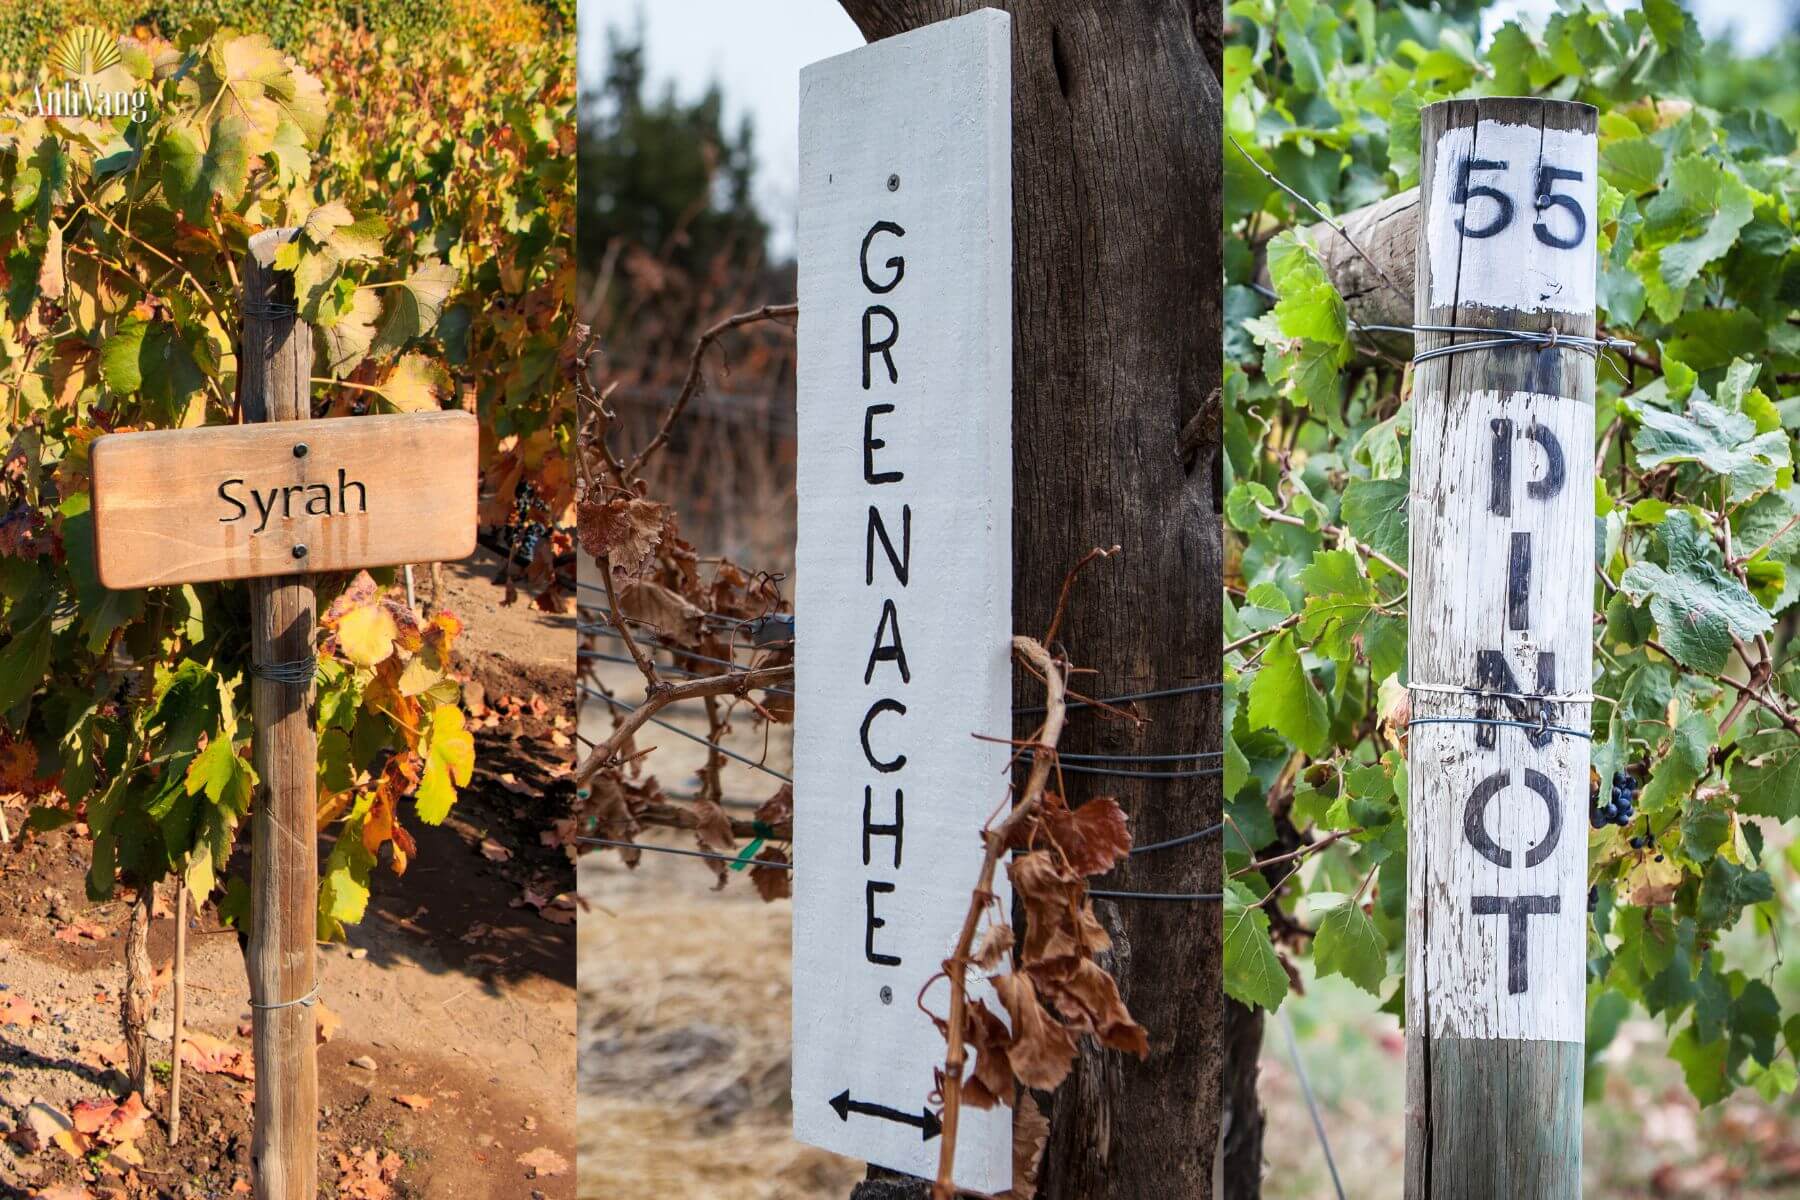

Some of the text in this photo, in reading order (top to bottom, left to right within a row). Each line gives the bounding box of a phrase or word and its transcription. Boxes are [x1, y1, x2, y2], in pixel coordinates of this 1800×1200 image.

[1453, 159, 1586, 250] 55
[217, 468, 367, 534] Syrah
[859, 219, 912, 967] GRENACHE
[1463, 417, 1567, 995] PINOT
